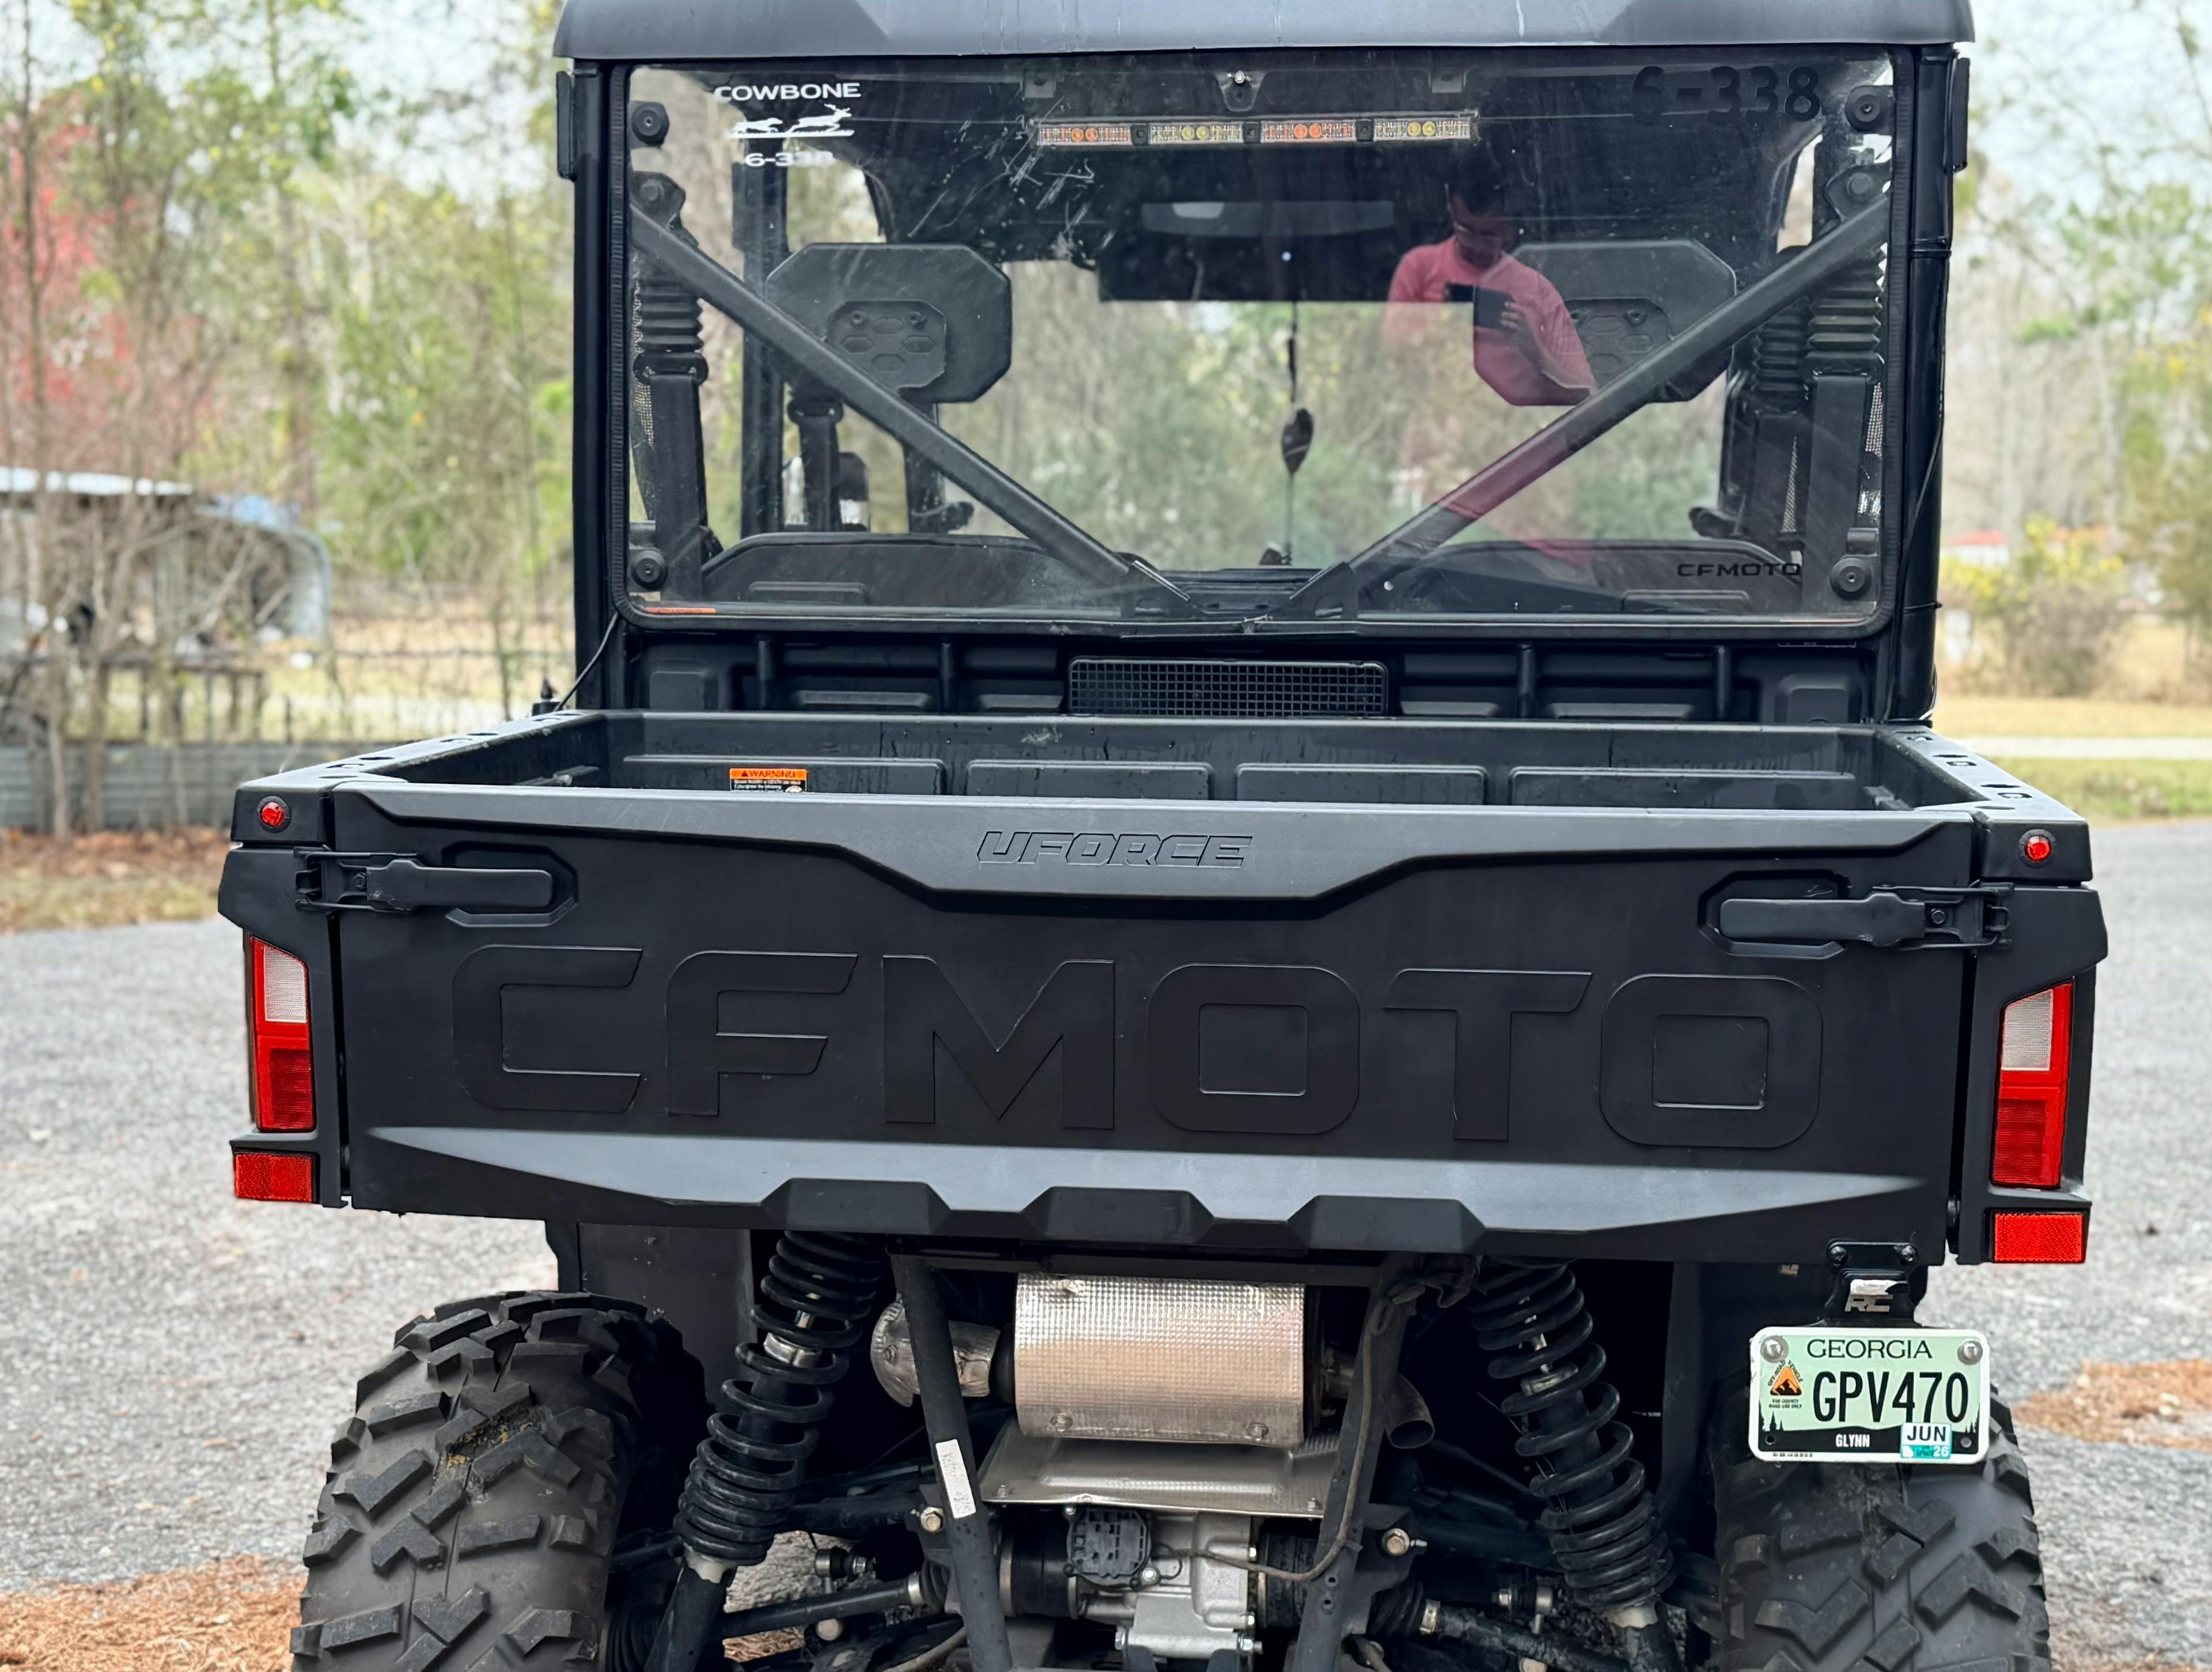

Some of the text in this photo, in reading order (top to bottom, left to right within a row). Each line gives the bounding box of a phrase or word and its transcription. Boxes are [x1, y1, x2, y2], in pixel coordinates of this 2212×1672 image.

[713, 82, 861, 103] COWBONE
[1631, 66, 1821, 123] 6-338
[1677, 562, 1801, 577] CFMOTO
[749, 770, 796, 778] WARNING
[977, 831, 1253, 869] UFORCE
[452, 944, 1823, 1149] CFMOTO
[1806, 1339, 1933, 1359] GEORGIA
[1813, 1371, 1969, 1423] GPV470
[1835, 1434, 1870, 1447] GLYNN
[1907, 1425, 1946, 1442] JUN
[1933, 1446, 1949, 1457] 26
